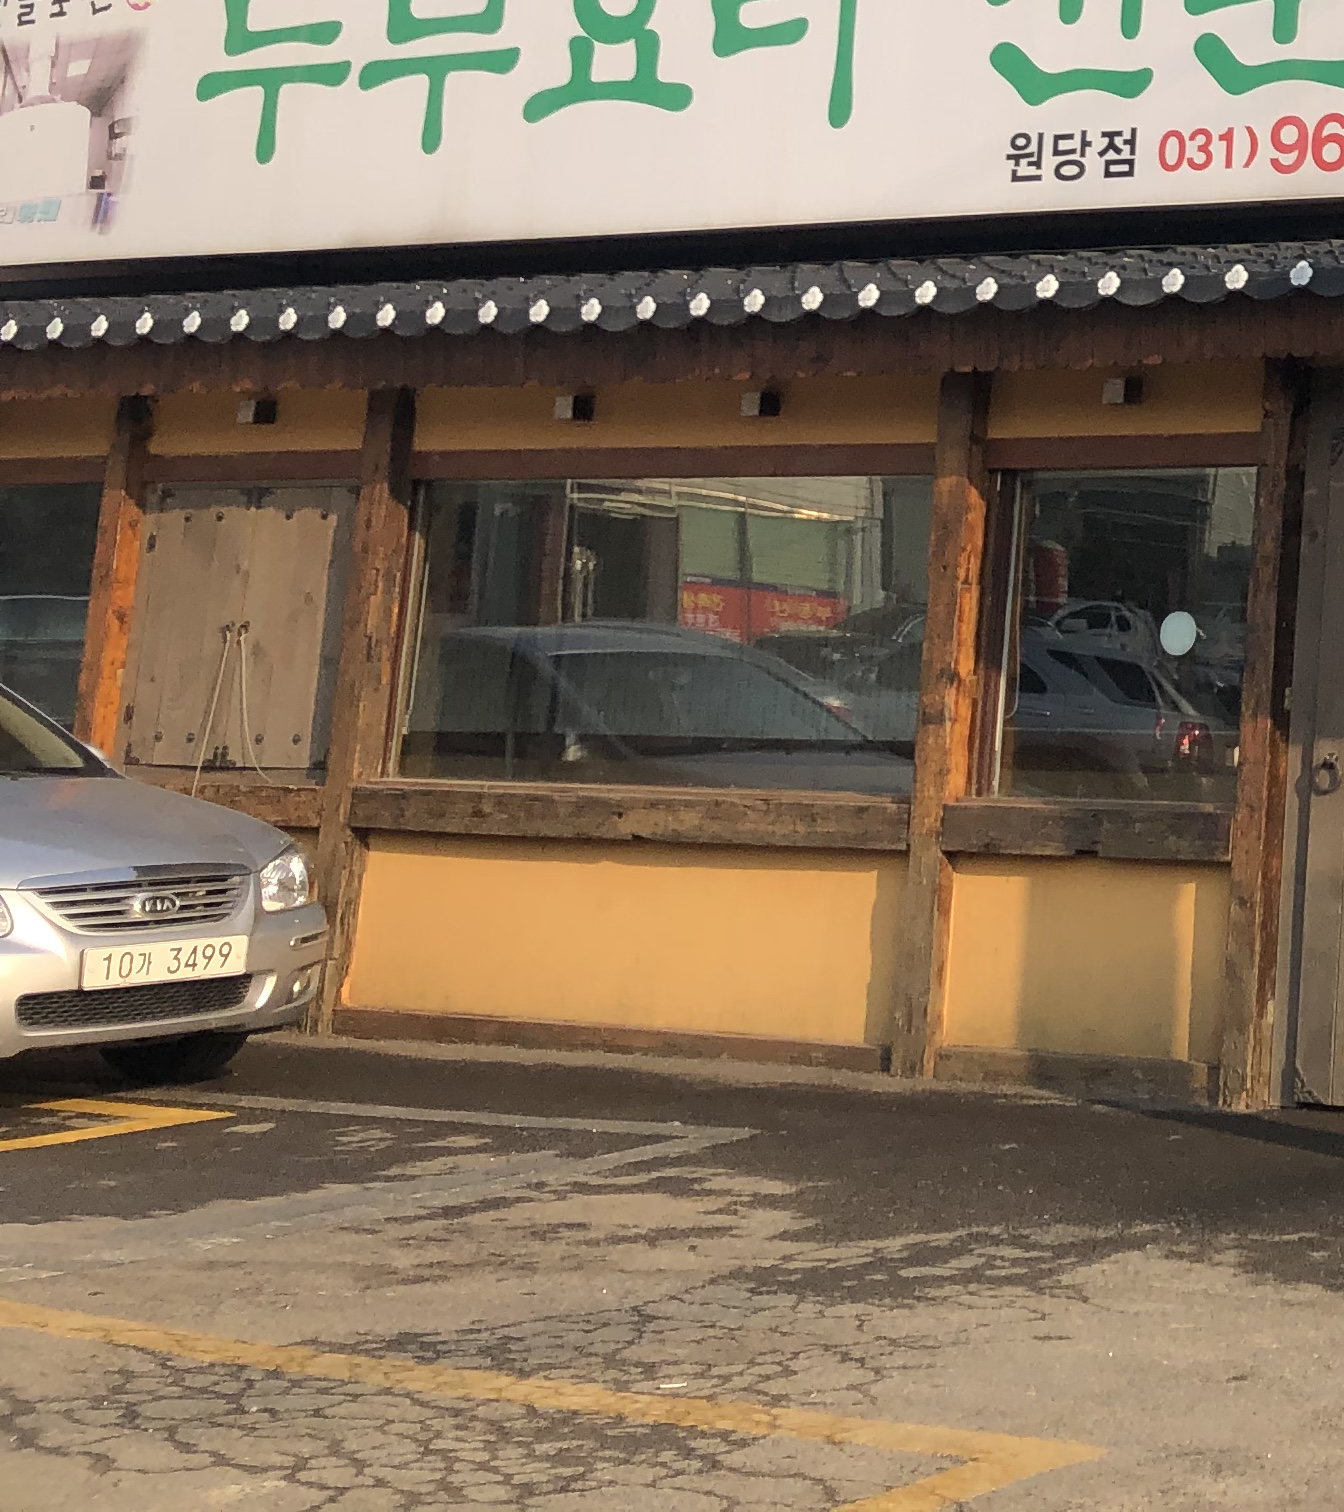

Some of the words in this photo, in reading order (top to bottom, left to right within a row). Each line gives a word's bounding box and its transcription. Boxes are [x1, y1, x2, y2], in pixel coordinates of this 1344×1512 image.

[1005, 126, 1139, 184] 원당점
[145, 899, 173, 912] KIA
[103, 951, 152, 980] 10가
[166, 941, 233, 974] 3499
